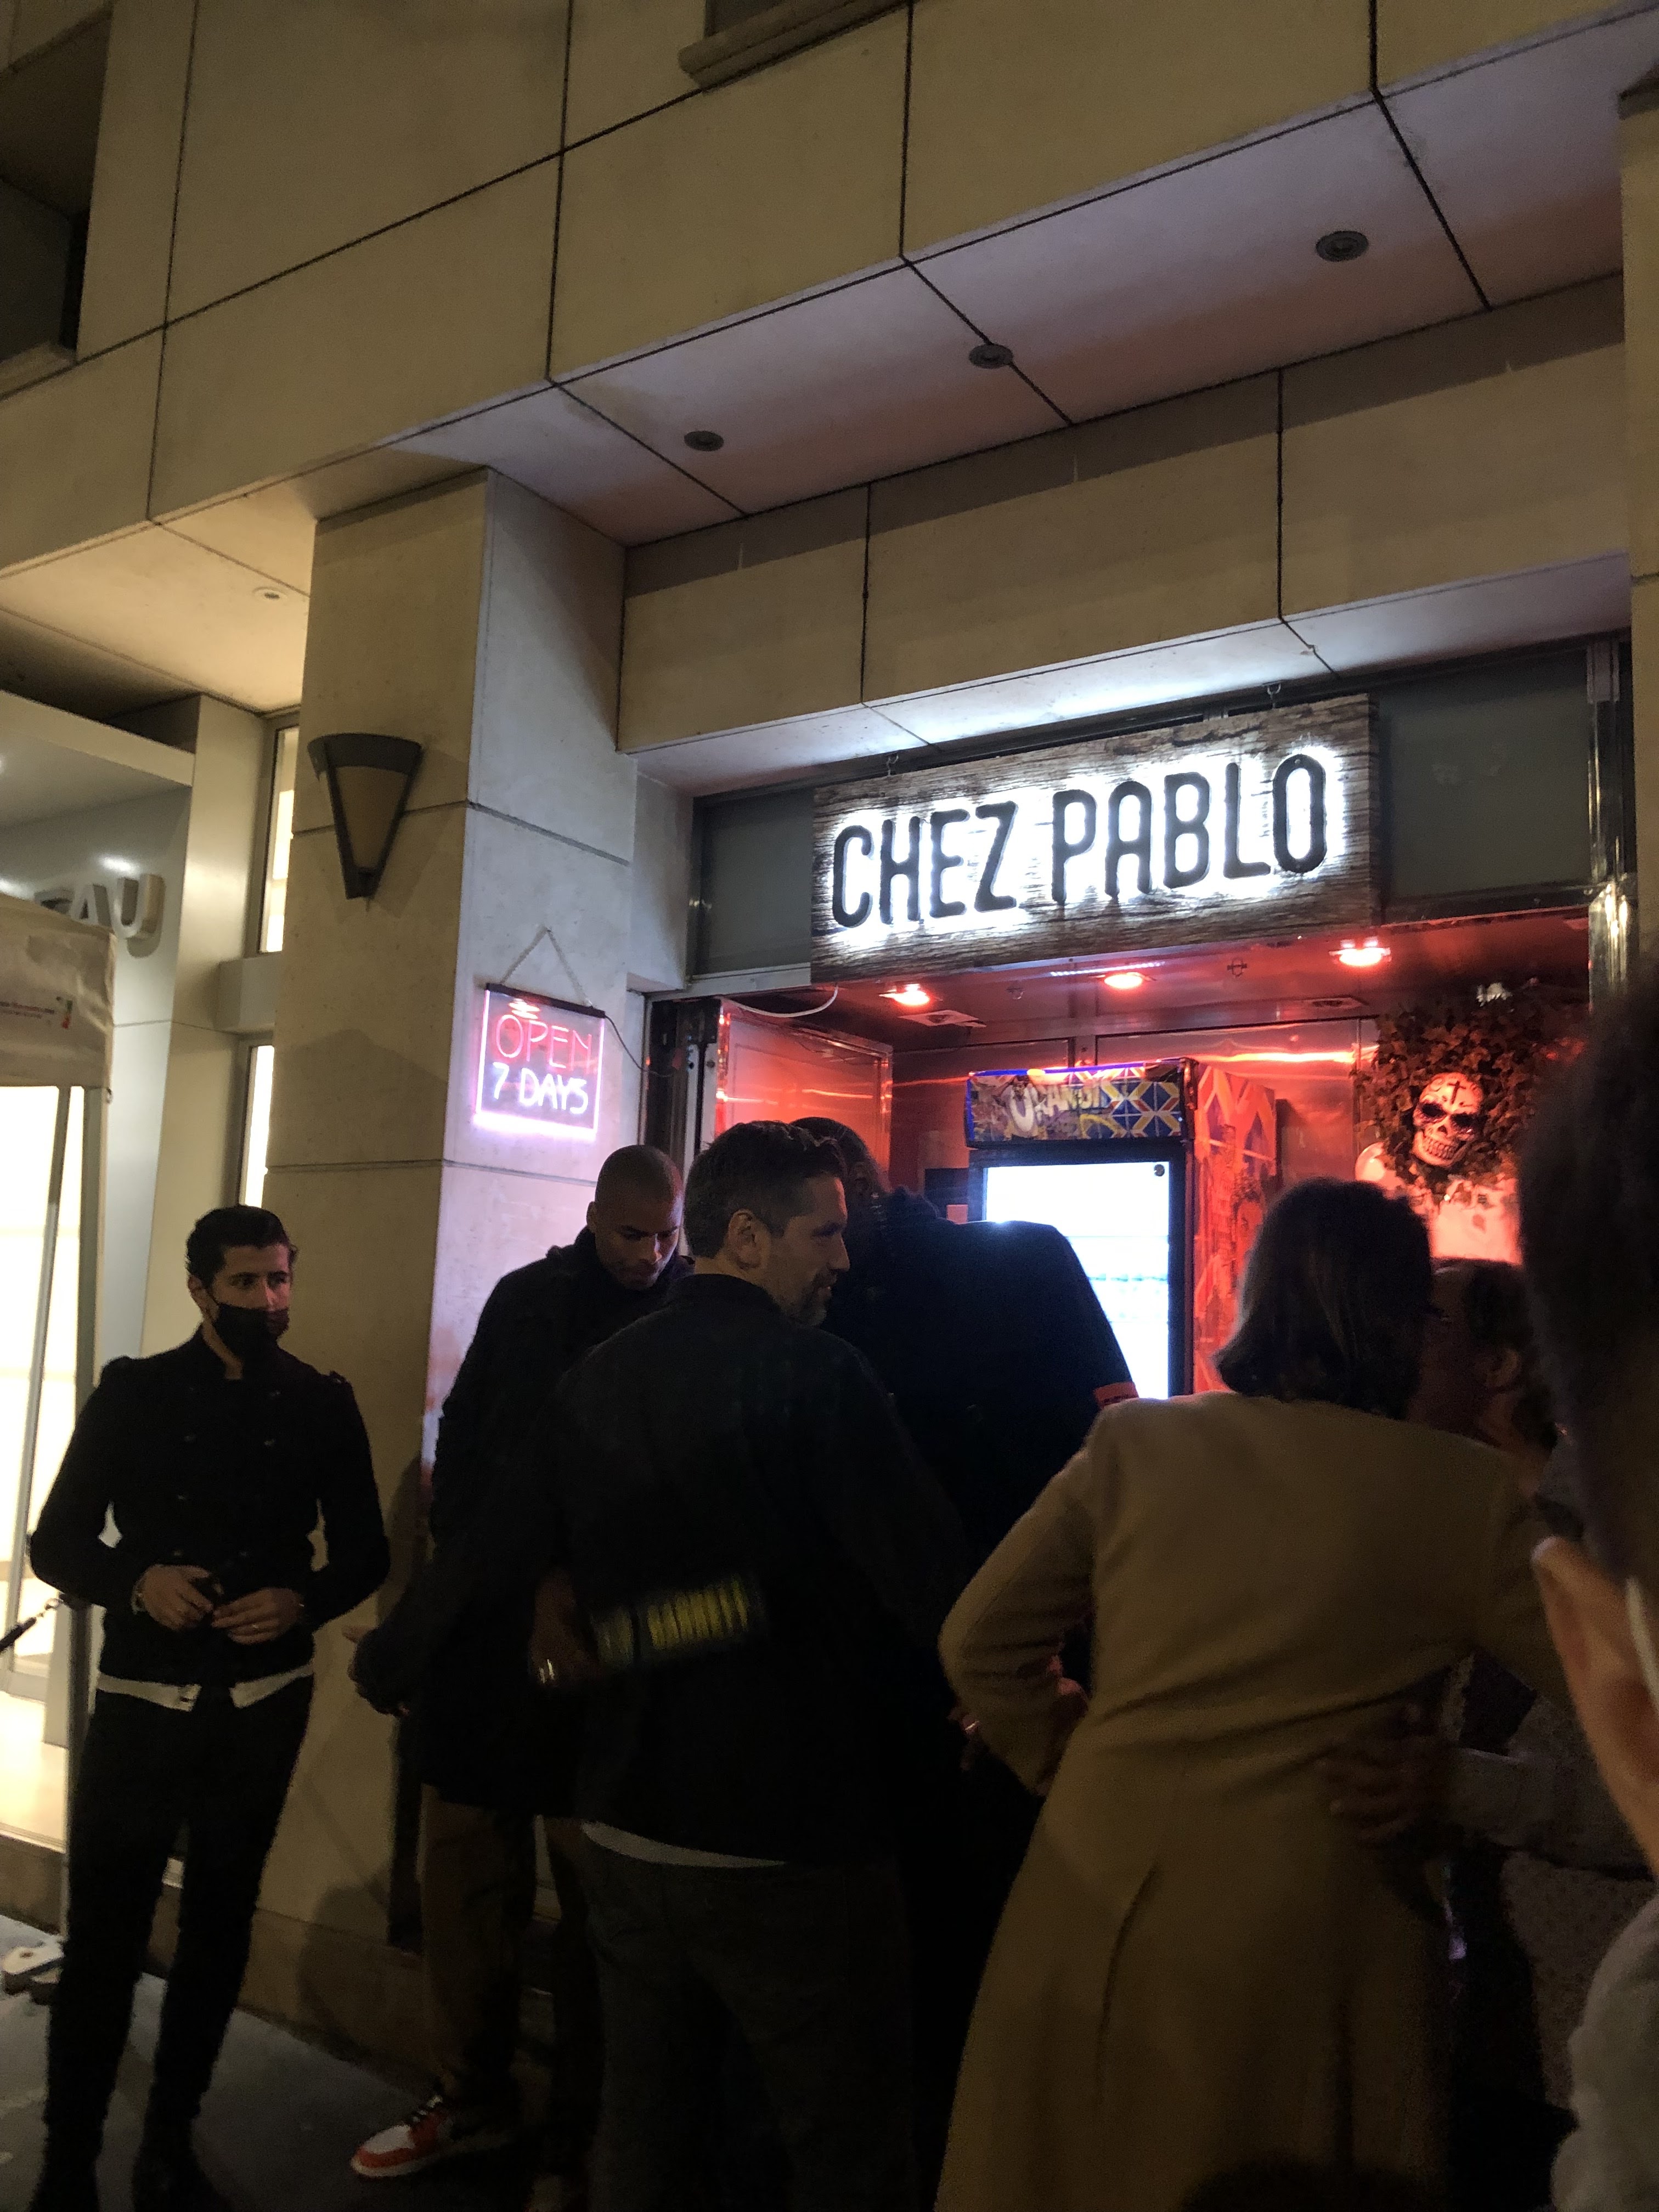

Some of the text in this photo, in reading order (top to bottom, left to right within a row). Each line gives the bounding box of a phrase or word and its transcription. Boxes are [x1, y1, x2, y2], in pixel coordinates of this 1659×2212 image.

[832, 754, 1327, 928] CHEZ PABLO
[495, 1014, 592, 1075] OPEN
[493, 1062, 589, 1114] 7 DAYS
